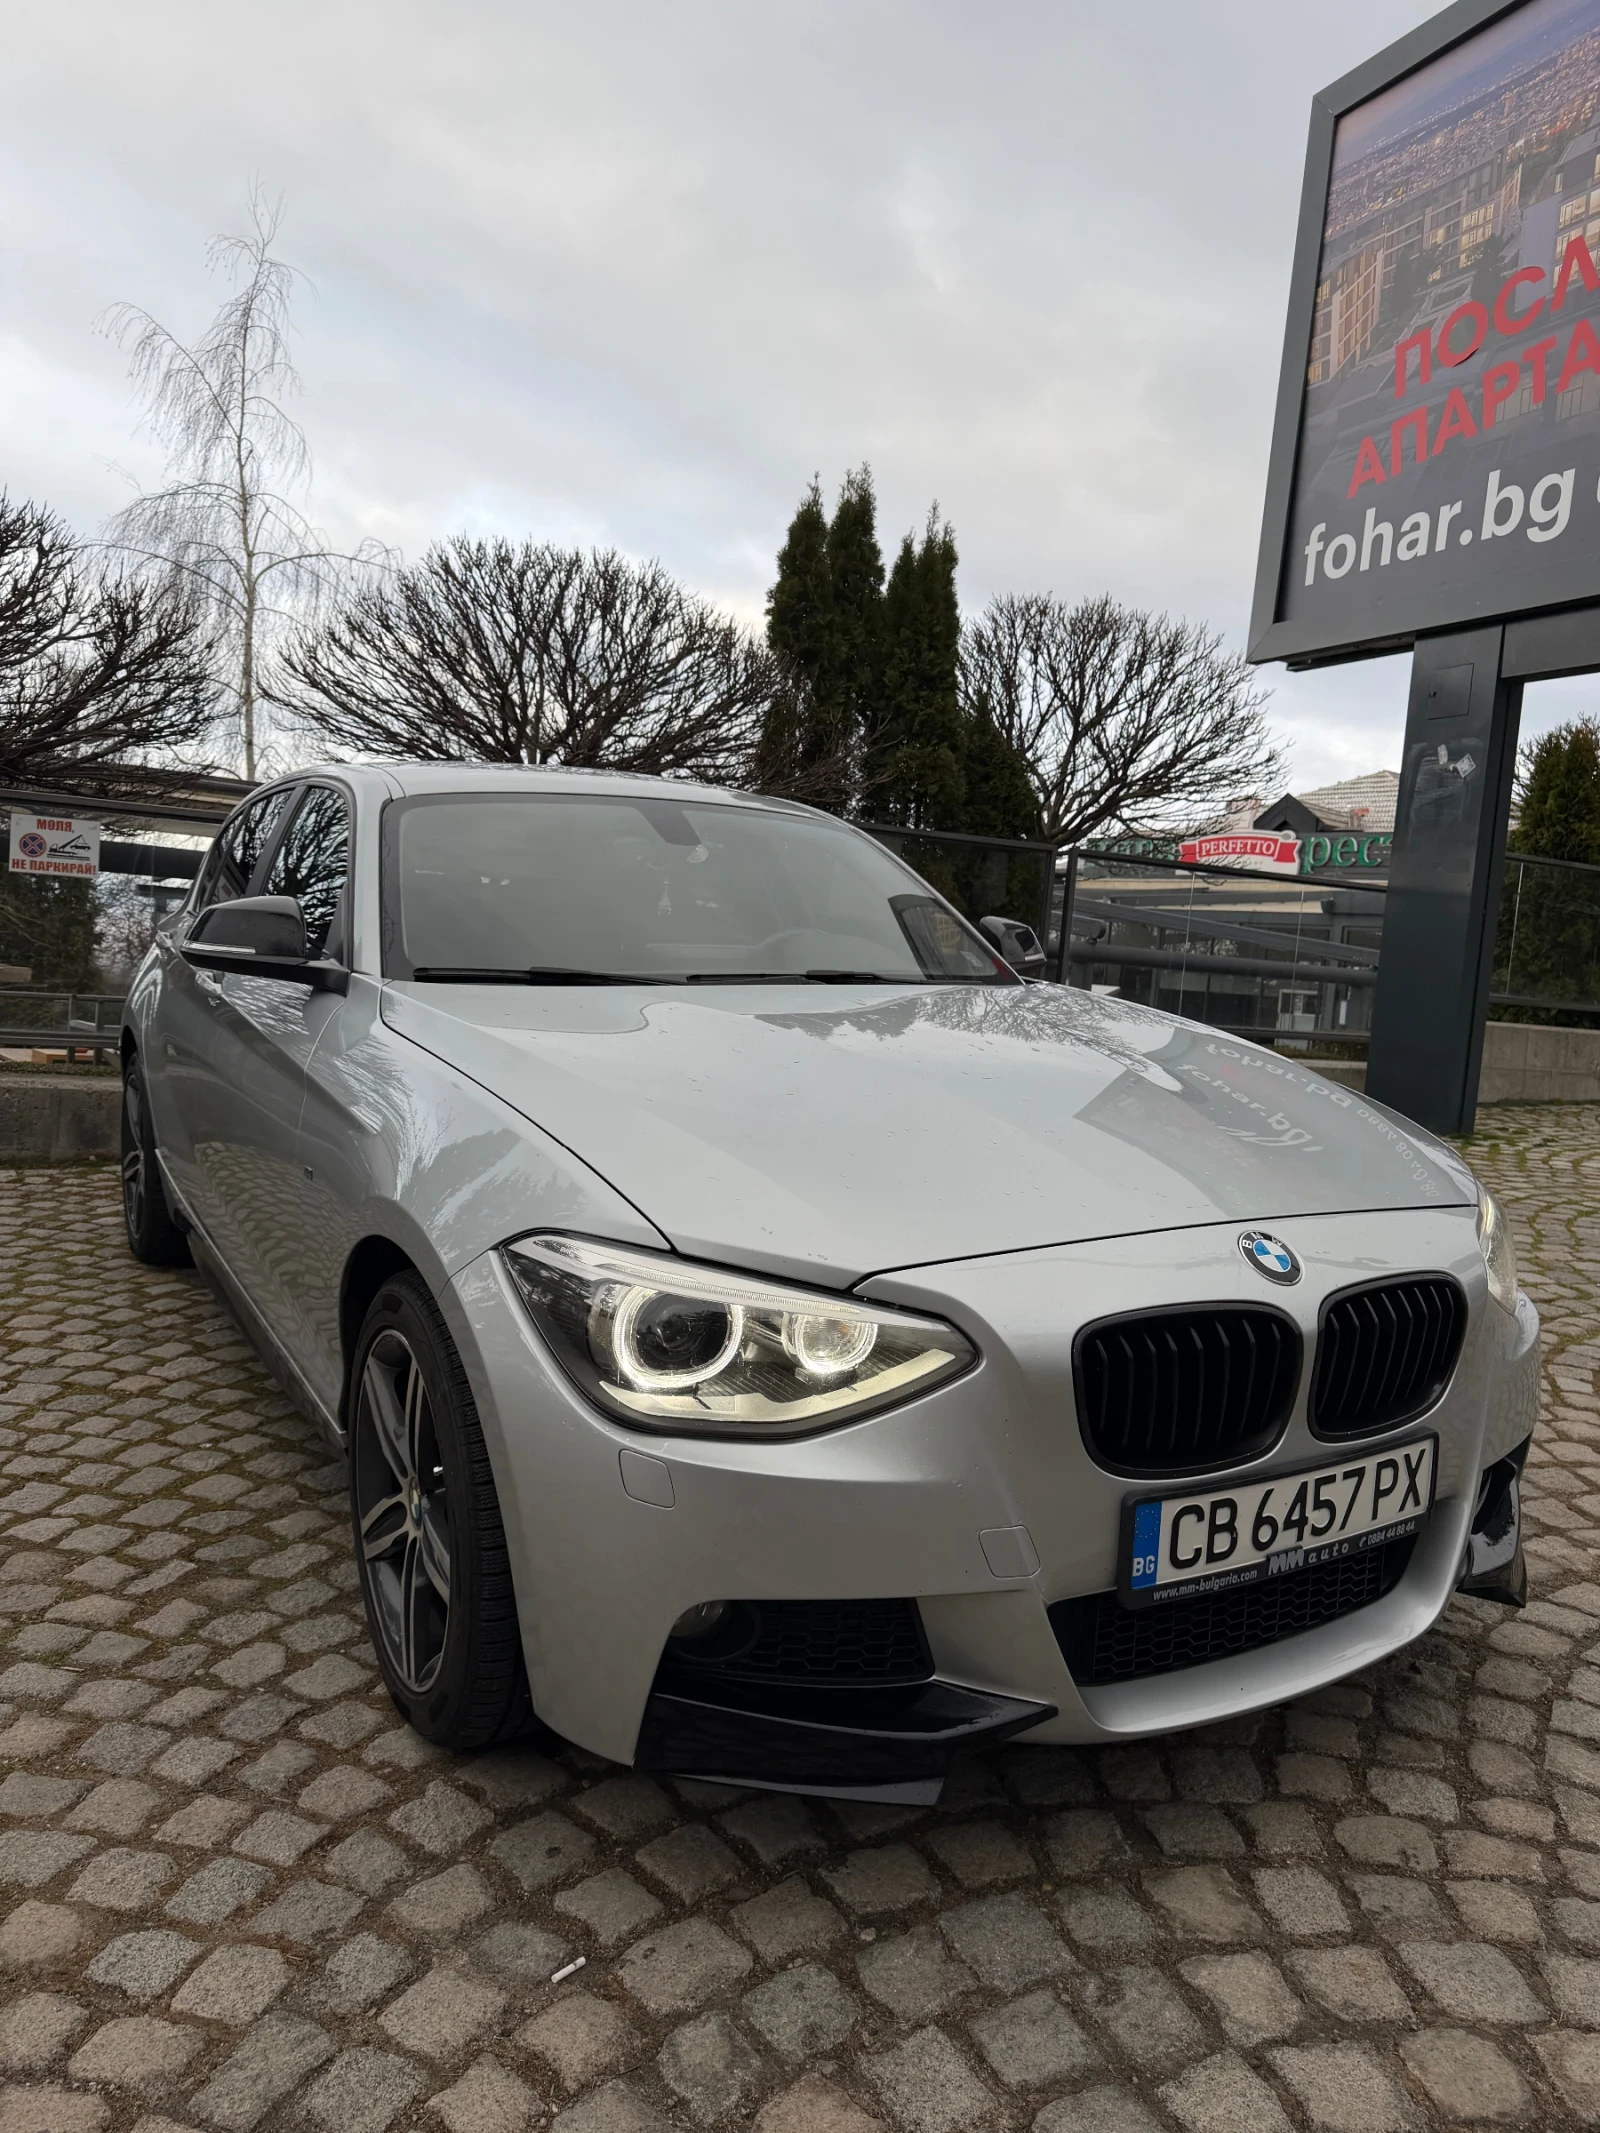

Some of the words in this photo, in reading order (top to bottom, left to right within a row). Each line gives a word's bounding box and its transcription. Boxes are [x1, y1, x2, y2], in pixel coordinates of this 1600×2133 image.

[1394, 234, 1600, 399] ПОСЛ
[1346, 318, 1600, 500] АПАРТА
[1304, 467, 1576, 587] fohar.bg
[36, 818, 75, 833] МОЛЯ,
[1201, 838, 1275, 856] PERFETTO
[11, 858, 26, 869] НЕ
[29, 859, 96, 875] ПАРКИРАЙ!
[1251, 1465, 1367, 1552] 6457
[1131, 1554, 1156, 1578] BG
[1267, 1547, 1304, 1576] MM
[1308, 1542, 1349, 1564] auto
[1153, 1568, 1258, 1601] www.mm-bulgaria.com
